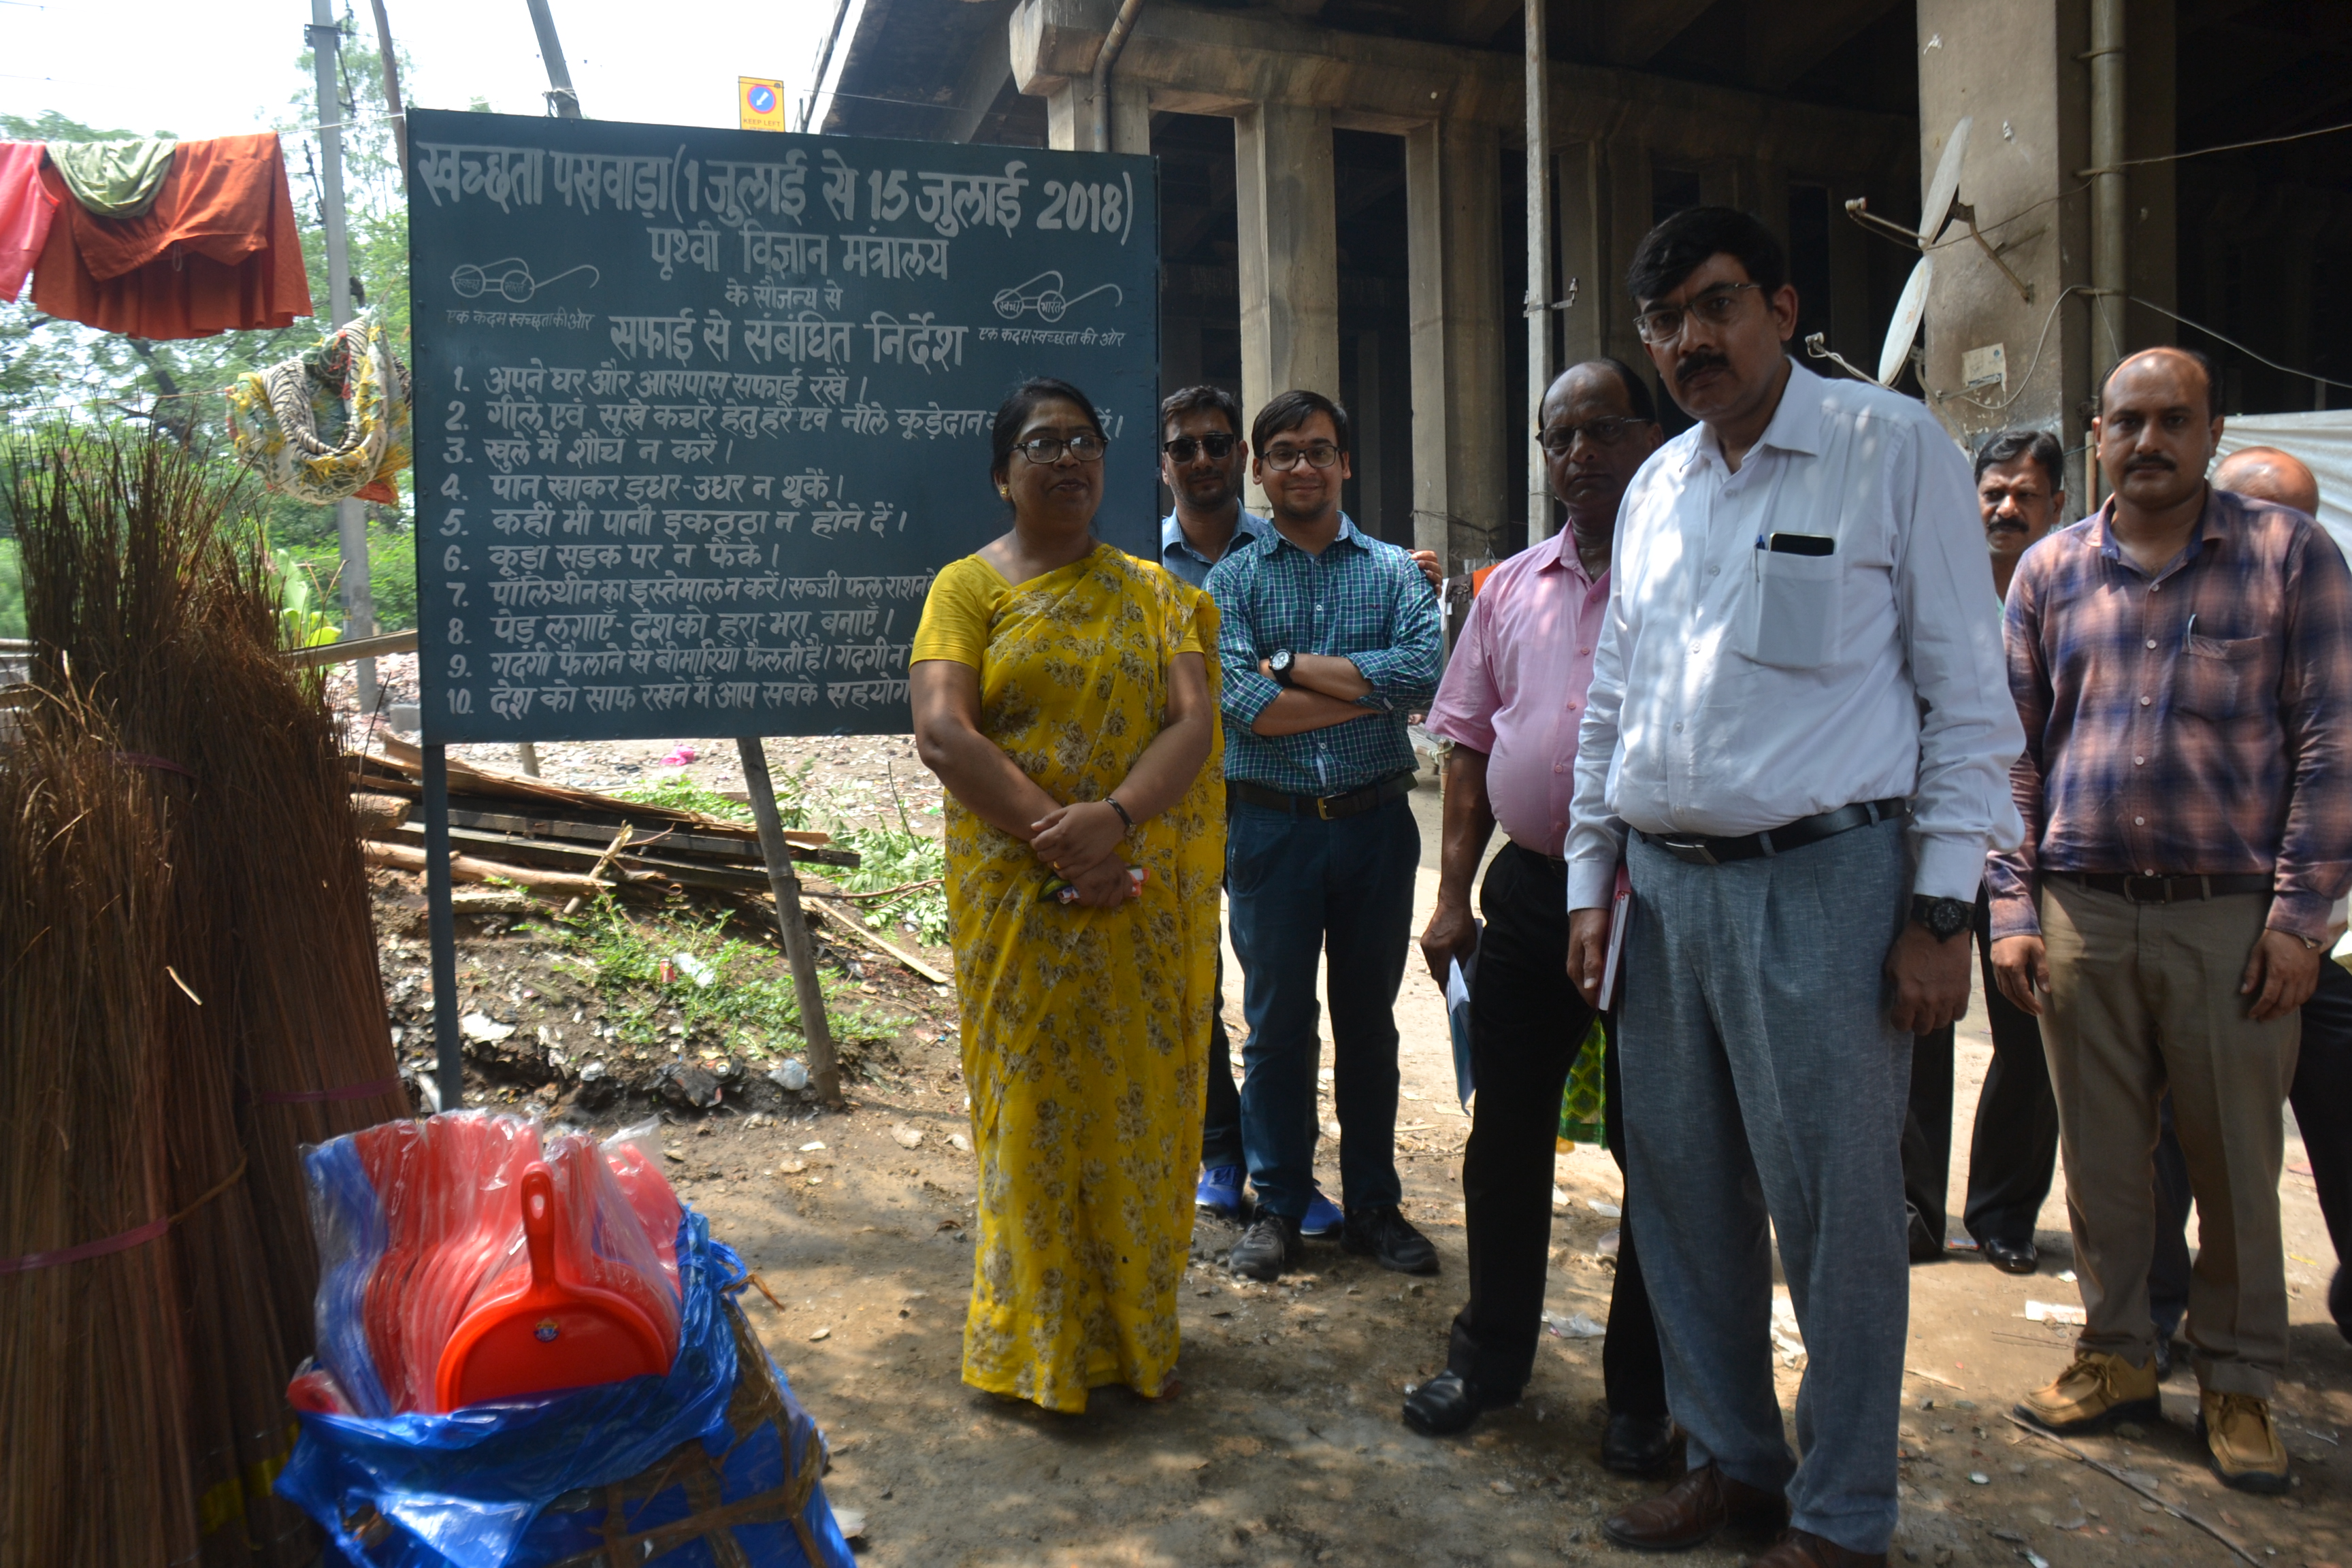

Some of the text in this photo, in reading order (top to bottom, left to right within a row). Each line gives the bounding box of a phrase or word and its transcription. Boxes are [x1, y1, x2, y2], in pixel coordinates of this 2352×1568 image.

[416, 141, 546, 214] स्वच्छता
[704, 148, 808, 227] जुलाई
[821, 149, 859, 221] से
[868, 169, 909, 222] 15
[915, 161, 1028, 238] जुलाई
[1036, 171, 1133, 246] 2018)
[646, 218, 949, 281] पृथ्वी विज्ञान मंत्रालय
[725, 275, 843, 311] के सौजन्य से
[1041, 299, 1062, 314] भारत
[446, 310, 470, 325] एक
[474, 310, 507, 328] कदम
[978, 327, 1126, 347] एक कदम स्वच्छता की ओर
[608, 308, 969, 375] सफाई से संबंधित निर्देश
[454, 366, 470, 392] 1.
[483, 357, 547, 395] अपने
[549, 367, 587, 396] घर
[587, 358, 634, 397] और
[635, 370, 732, 399] आसपास
[732, 368, 803, 406] सफाई
[808, 368, 849, 405] रखें
[444, 400, 470, 431] 2.
[485, 393, 544, 434] गीले
[547, 397, 588, 431] एवं
[596, 398, 651, 436] सूखे
[653, 398, 717, 430] कचरे
[720, 397, 760, 439] हेतु
[760, 400, 797, 439] हरे
[798, 402, 832, 432] एवं
[840, 402, 889, 435] नीले
[895, 402, 984, 440] कूड़ेदान
[442, 437, 474, 463] 3.
[483, 431, 532, 474] खुले
[536, 430, 561, 464] में
[566, 429, 626, 469] शौच
[636, 439, 663, 464] न
[670, 432, 718, 465] करें
[440, 473, 470, 501] 4.
[488, 474, 543, 502] पान
[546, 475, 621, 502] खाकर
[753, 476, 775, 501] न
[781, 468, 830, 508] थूकें
[439, 508, 470, 537] 5.
[491, 500, 556, 538] कहीं
[562, 501, 594, 536] भी
[600, 503, 657, 537] पानी
[776, 511, 800, 533] न
[811, 501, 866, 540] होने
[870, 502, 893, 538] दें
[443, 544, 470, 572] 6.
[555, 544, 622, 575] सड़क
[627, 544, 664, 569] पर
[672, 544, 697, 568] न
[446, 582, 470, 608] 7.
[599, 579, 628, 604] का
[628, 570, 723, 608] इस्तेमाल
[724, 577, 743, 601] न
[788, 570, 842, 601] सब्जी
[844, 576, 885, 601] फल
[885, 574, 929, 601] राशन
[448, 617, 472, 645] 8.
[630, 608, 676, 648] देश
[675, 605, 710, 640] को
[448, 654, 472, 678] 9.
[556, 640, 626, 677] फैलाने
[627, 642, 655, 674] से
[744, 638, 807, 674] फैलती
[835, 636, 892, 674] गंदगी
[891, 644, 909, 670] न
[446, 687, 474, 715] 10.
[489, 679, 538, 721] देश
[540, 679, 579, 713] को
[583, 685, 636, 713] साफ
[639, 676, 692, 712] रखने
[692, 674, 715, 708] में
[715, 681, 760, 708] आप
[762, 674, 818, 710] सबके
